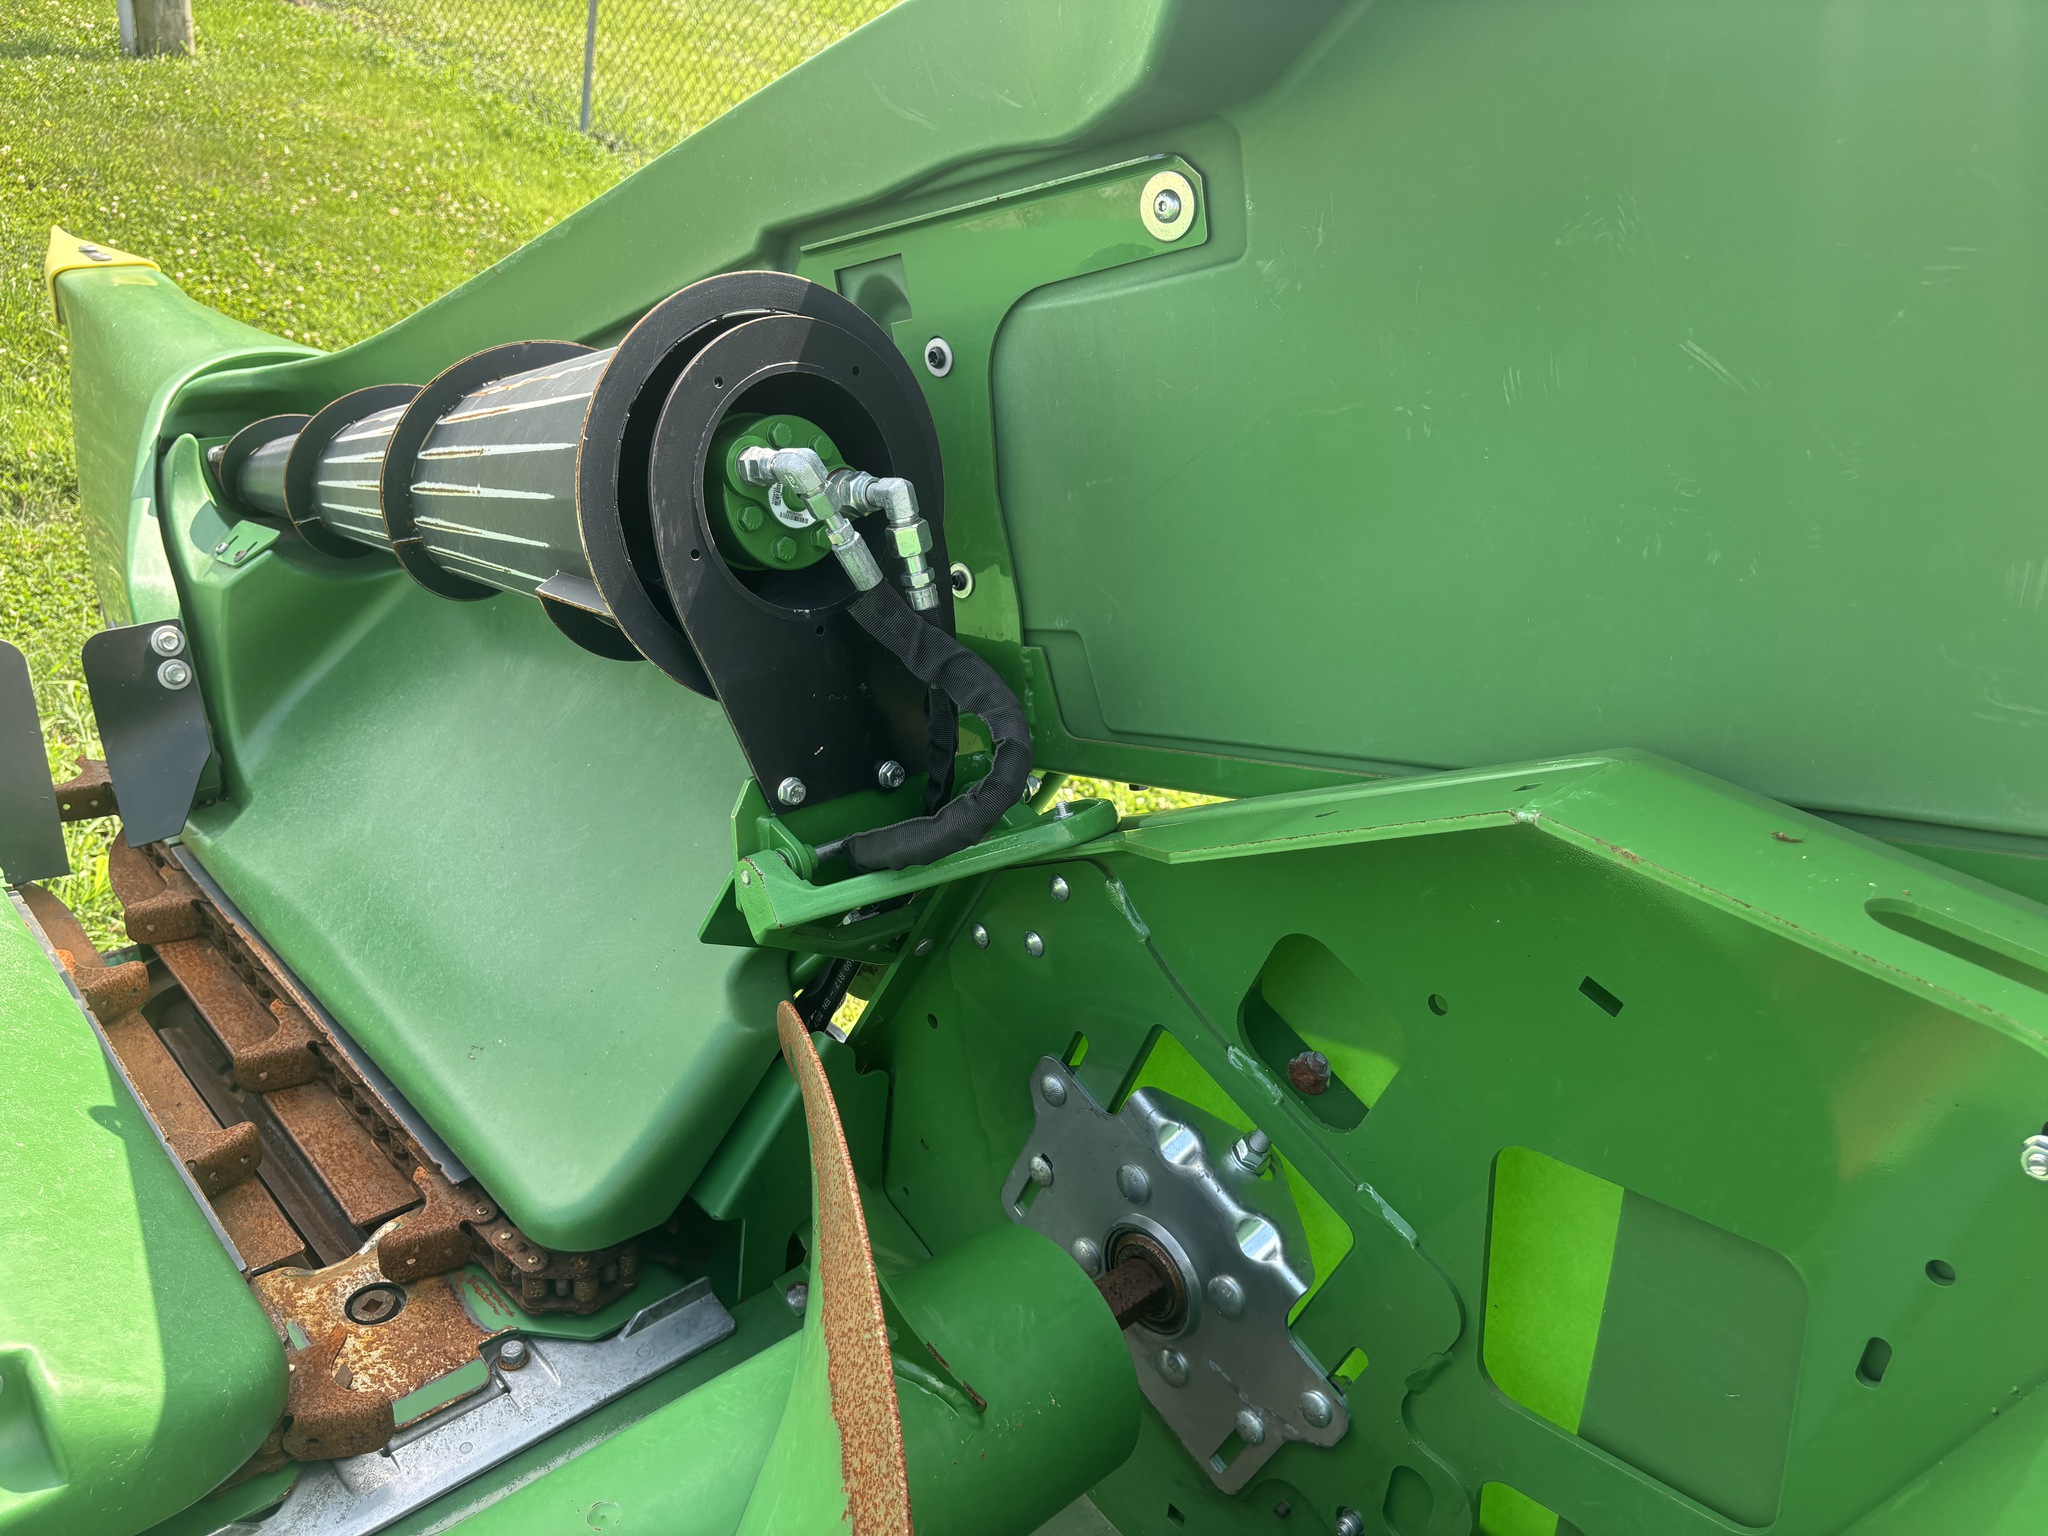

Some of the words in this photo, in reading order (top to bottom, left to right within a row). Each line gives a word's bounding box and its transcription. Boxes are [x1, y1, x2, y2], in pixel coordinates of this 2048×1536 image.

[834, 972, 846, 989] R17
[821, 997, 831, 1010] EN
[813, 1011, 824, 1028] 857
